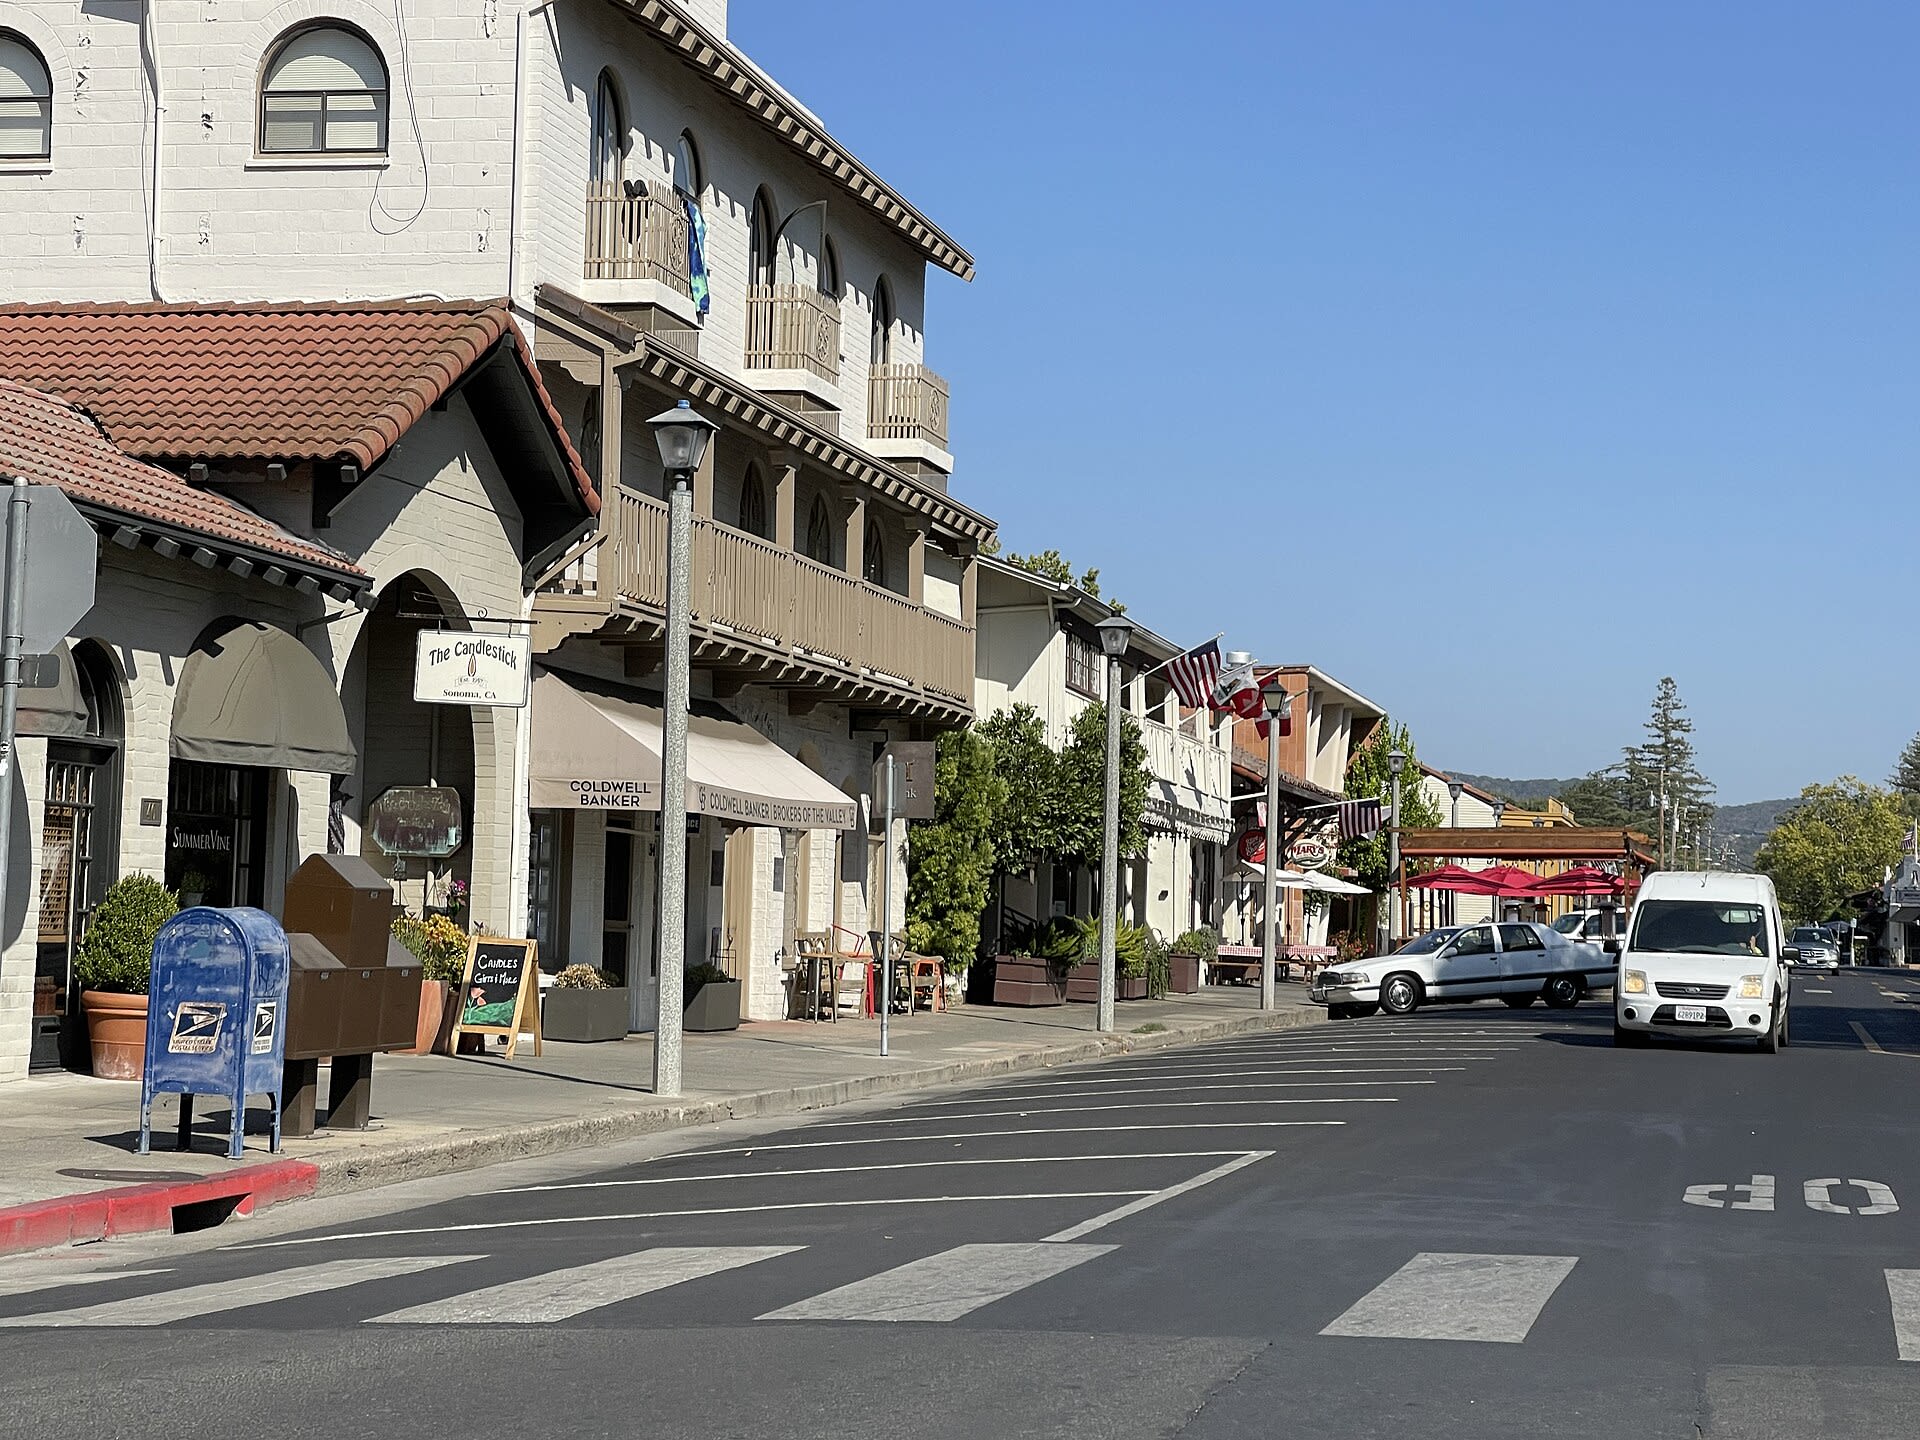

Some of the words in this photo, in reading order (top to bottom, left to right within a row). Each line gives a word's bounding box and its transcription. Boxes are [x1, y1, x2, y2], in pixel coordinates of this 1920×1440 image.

[429, 647, 450, 666] The
[454, 639, 517, 670] Candlestick
[442, 689, 482, 699] Sonoma,
[484, 690, 497, 699] CA
[570, 780, 651, 794] COLDWELL
[580, 794, 640, 807] BANKER
[710, 792, 743, 816] COLDWELL
[744, 799, 769, 820] BANKER
[773, 804, 802, 822] BROKERS
[802, 807, 811, 823] OF
[812, 807, 824, 823] THE
[825, 808, 846, 825] VALLEY
